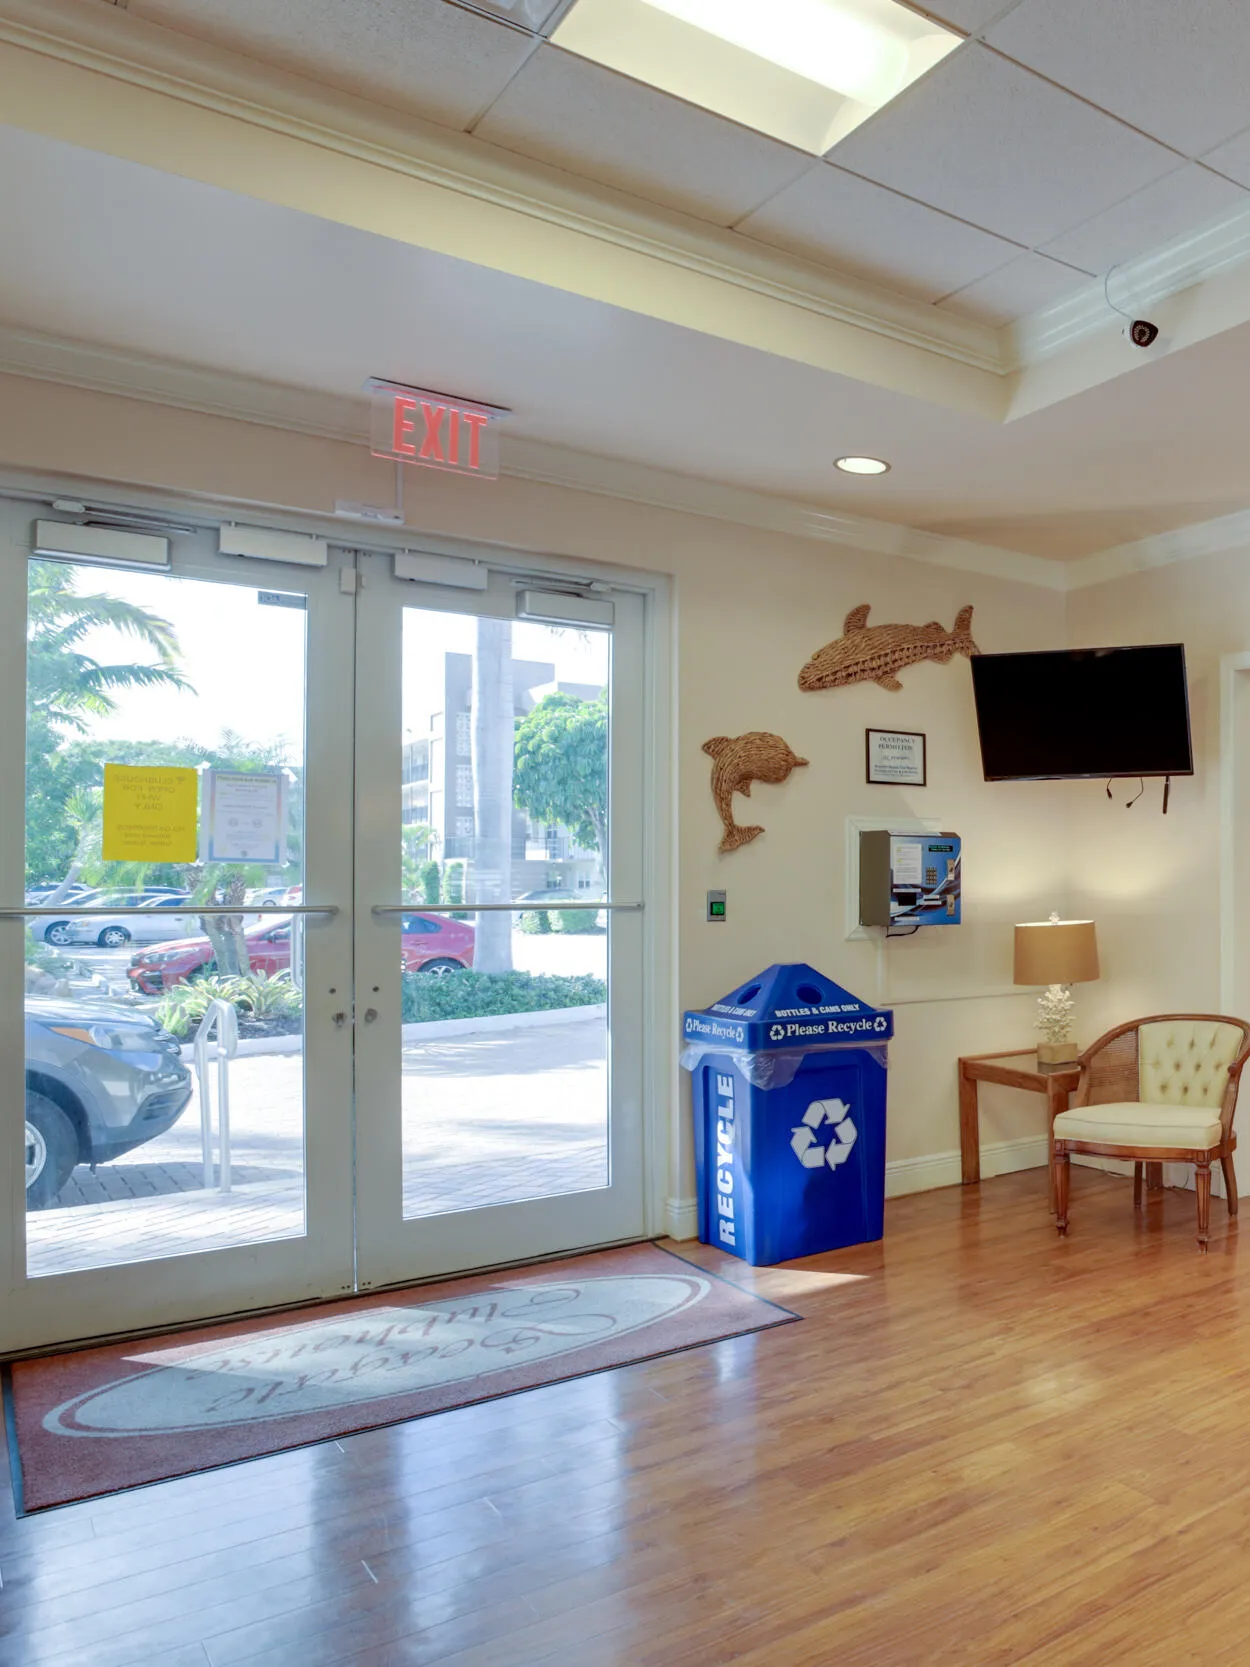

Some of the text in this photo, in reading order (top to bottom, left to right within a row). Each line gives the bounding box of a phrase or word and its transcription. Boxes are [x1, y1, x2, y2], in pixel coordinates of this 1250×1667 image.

[392, 395, 488, 469] EXIT
[774, 1003, 860, 1018] BOTTLES & CANS ONLY
[693, 1018, 736, 1040] Please Recycle
[786, 1018, 873, 1037] Please Recycle
[717, 1074, 736, 1247] RECYCLE
